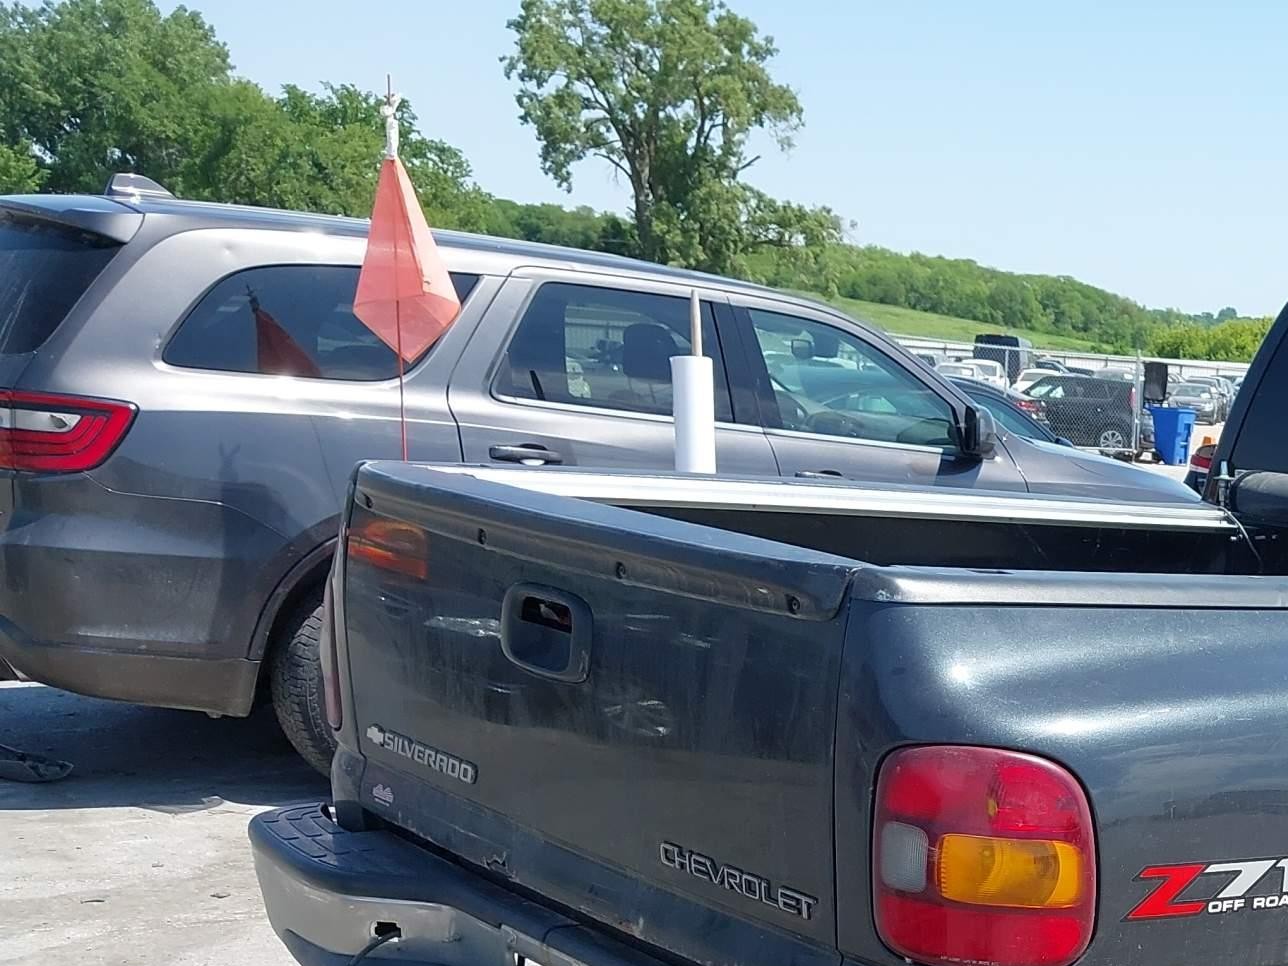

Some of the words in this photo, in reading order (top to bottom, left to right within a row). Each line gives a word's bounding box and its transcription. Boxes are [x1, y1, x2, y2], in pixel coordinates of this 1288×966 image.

[384, 732, 475, 784] SILVERADO
[659, 842, 818, 920] CHEVROLET
[1207, 897, 1246, 914] OFF
